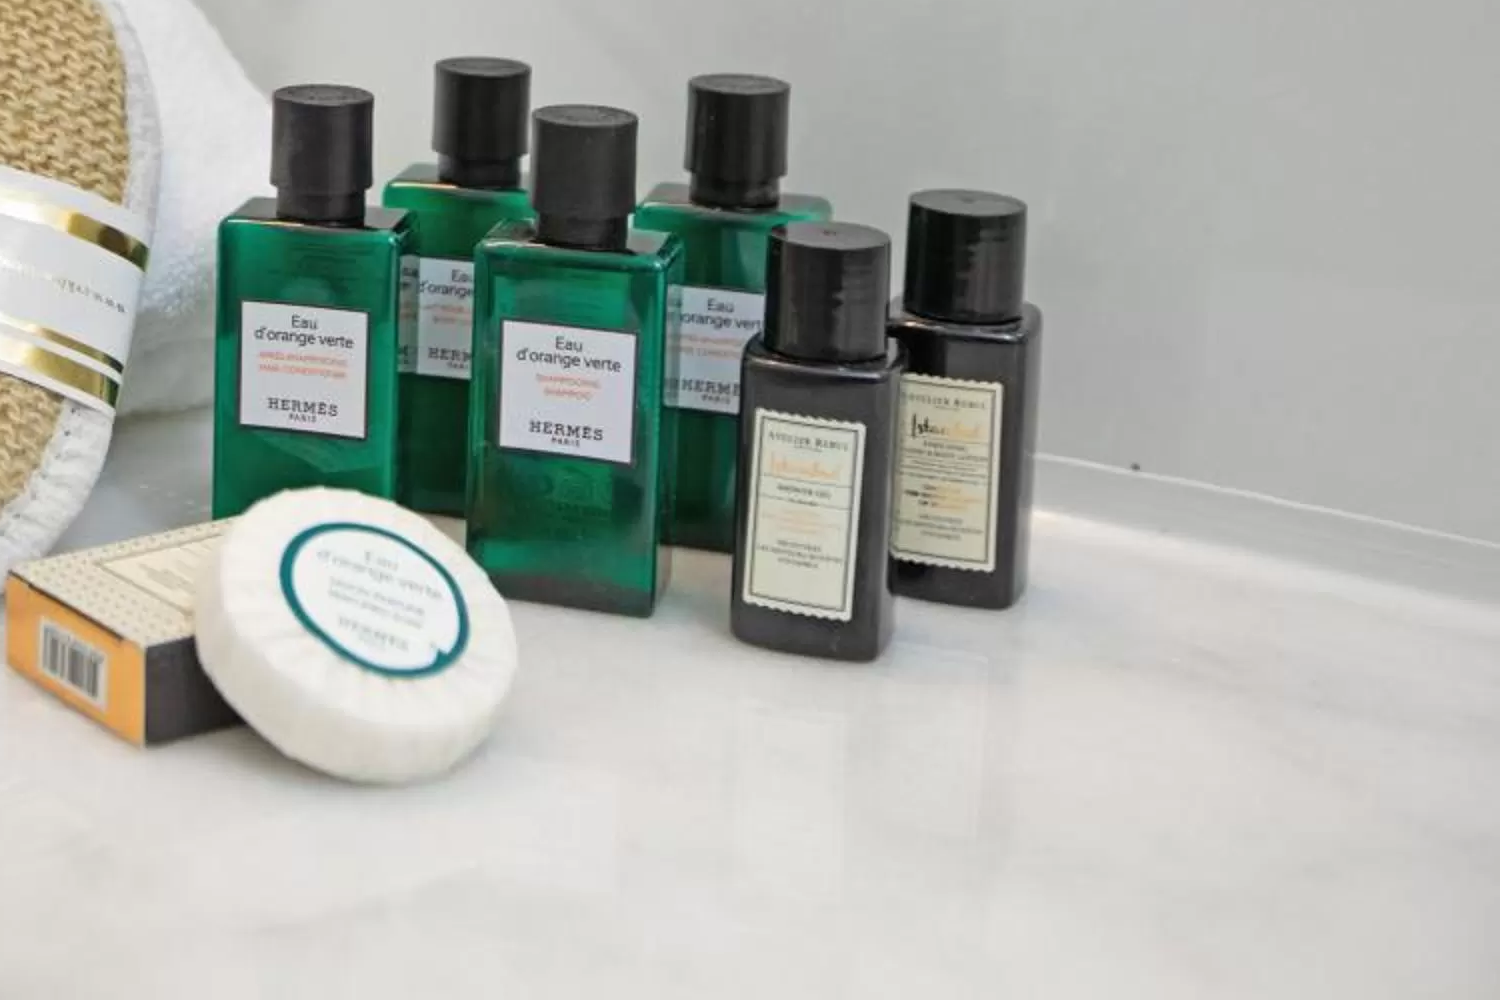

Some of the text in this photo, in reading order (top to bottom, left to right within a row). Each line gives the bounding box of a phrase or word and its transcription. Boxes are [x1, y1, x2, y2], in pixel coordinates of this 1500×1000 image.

[707, 298, 735, 313] Eau
[291, 315, 318, 331] Eau
[254, 327, 355, 349] d'orange verte
[555, 336, 583, 352] Eau
[516, 347, 622, 373] d'orange verte
